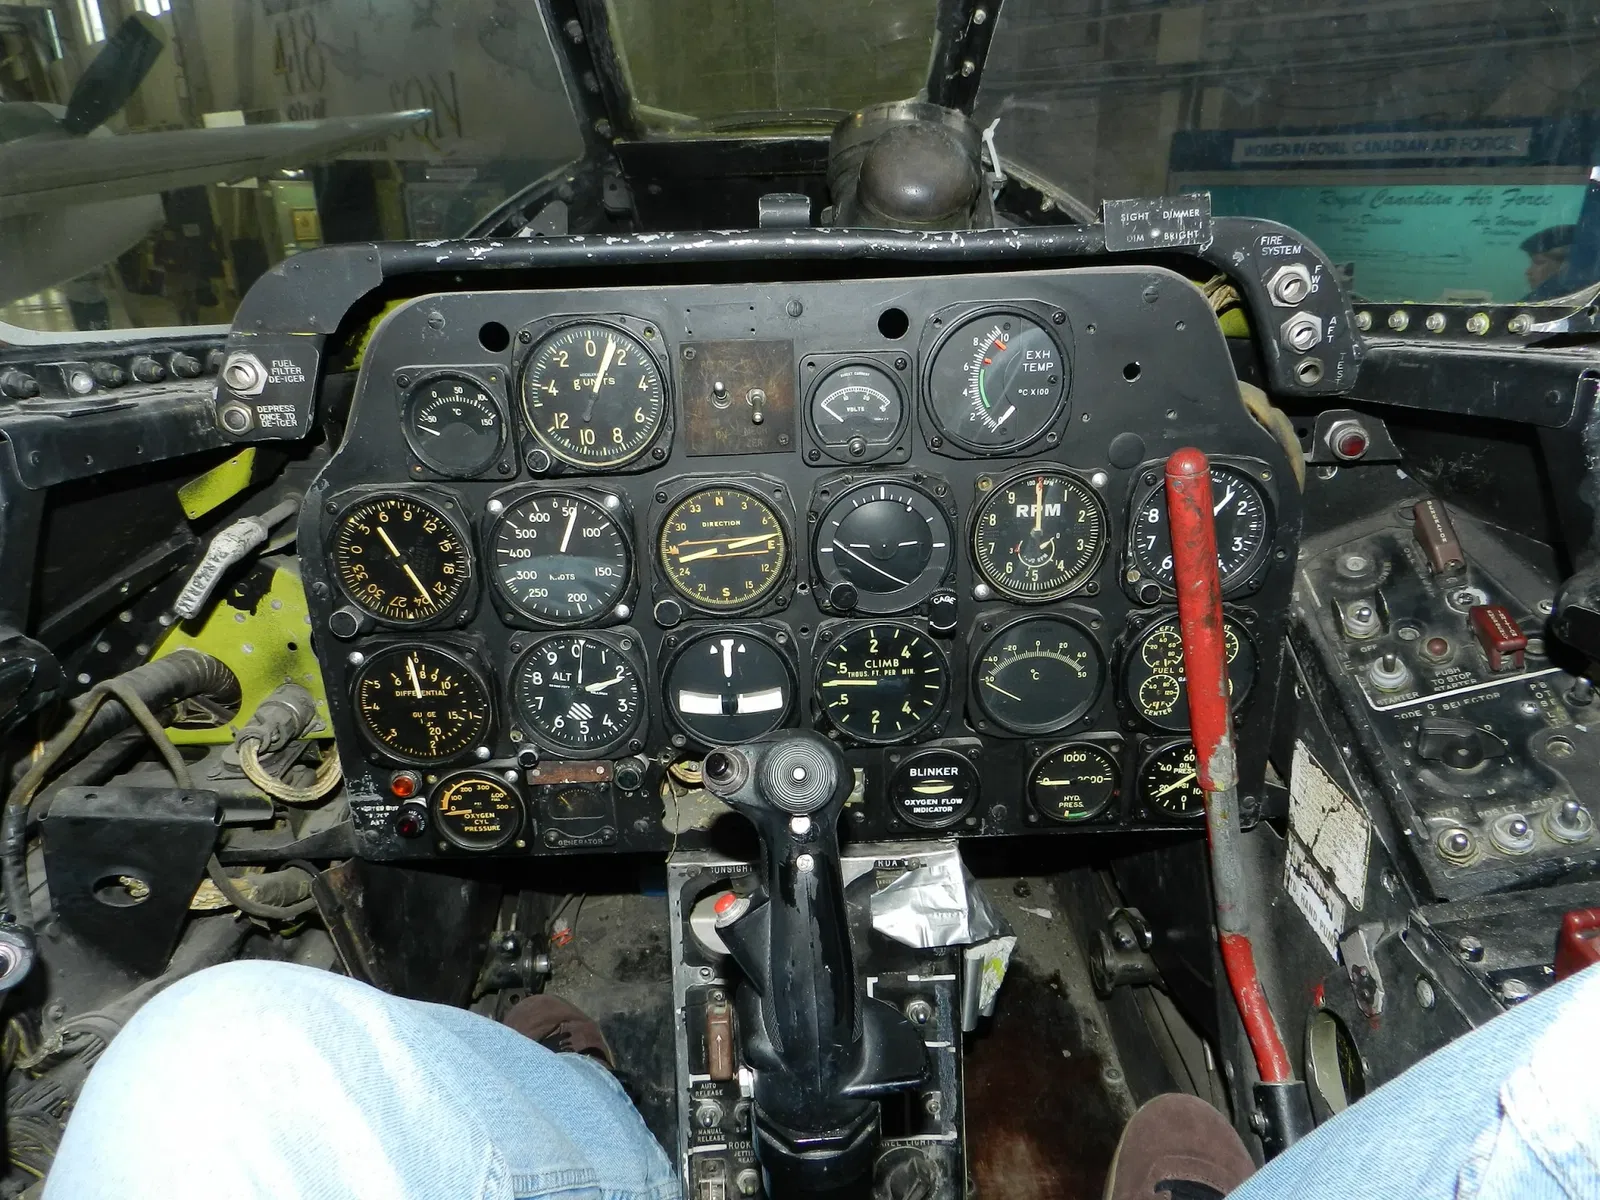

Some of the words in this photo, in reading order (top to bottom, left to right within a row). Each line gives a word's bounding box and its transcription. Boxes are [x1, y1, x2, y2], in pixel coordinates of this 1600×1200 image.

[1244, 142, 1290, 157] WOMEN
[1308, 140, 1349, 155] ROYAL
[1353, 138, 1427, 154] CANADIAN
[1432, 137, 1458, 152] AIR
[1460, 136, 1516, 152] FORCE
[1317, 189, 1366, 210] Royal
[1369, 188, 1453, 210] Canadian
[1458, 188, 1493, 207] Air
[1501, 188, 1553, 209] Force
[1120, 211, 1150, 222] SIGHT
[1162, 208, 1200, 221] DIMMER
[1126, 234, 1145, 243] DIM
[1163, 229, 1200, 242] BRIGHT
[1260, 235, 1283, 246] FIRE
[1261, 245, 1302, 256] SYSTEM
[1310, 264, 1323, 293] FWD
[1326, 316, 1338, 344] AFT
[585, 339, 597, 357] 0
[553, 350, 569, 368] -2
[616, 348, 627, 366] 2
[1026, 350, 1051, 360] EXH
[272, 359, 296, 367] FUEL
[1022, 362, 1054, 372] TEMP
[271, 366, 302, 375] FILTER
[1334, 352, 1347, 386] TEST
[541, 379, 559, 396] -4
[638, 375, 649, 391] 4
[453, 386, 464, 394] 50
[1030, 388, 1050, 396] X100
[256, 404, 296, 413] DEPRESS
[259, 413, 281, 421] ONCE
[286, 412, 296, 420] TO
[634, 406, 645, 423] 6
[554, 412, 570, 429] 12
[579, 428, 595, 445] 10
[612, 427, 624, 443] 8
[715, 496, 724, 506] N
[1008, 492, 1016, 504] 9
[690, 504, 702, 513] 33
[1015, 503, 1061, 518] RPM
[1236, 501, 1248, 516] 2
[379, 511, 389, 522] 6
[403, 510, 413, 521] 9
[529, 512, 550, 523] 600
[989, 513, 997, 526] 8
[1078, 510, 1086, 523] 2
[1148, 508, 1159, 523] 8
[358, 524, 371, 535] 3
[422, 519, 438, 534] 12
[675, 523, 687, 531] 30
[702, 520, 741, 528] DIRECTION
[515, 529, 537, 539] 500
[582, 528, 601, 538] 100
[438, 539, 453, 552] 15
[1076, 538, 1084, 551] 3
[1146, 535, 1157, 550] 7
[1231, 537, 1243, 551] 3
[351, 545, 363, 554] 0
[509, 548, 531, 558] 400
[761, 563, 769, 572] 12
[1005, 561, 1013, 574] 6
[1161, 555, 1172, 570] 6
[352, 563, 369, 581] 33
[443, 562, 455, 575] 18
[594, 567, 612, 576] 150
[679, 567, 691, 576] 24
[516, 570, 537, 580] 300
[432, 581, 447, 596] 21
[698, 583, 706, 592] 21
[745, 580, 754, 589] 15
[367, 583, 386, 599] 30
[528, 588, 549, 598] 250
[722, 587, 731, 597] S
[389, 596, 407, 608] 27
[567, 593, 587, 603] 200
[933, 595, 956, 605] CAGE
[571, 644, 580, 658] 0
[869, 639, 878, 653] 2
[1359, 643, 1378, 653] OFF
[901, 645, 911, 659] 4
[546, 651, 558, 665] 9
[864, 659, 900, 669] CLIMB
[551, 671, 572, 682] ALT
[615, 665, 626, 679] 2
[848, 670, 870, 678] THOUS.
[871, 669, 881, 677] FT.
[1434, 666, 1461, 677] PUSH
[1446, 671, 1472, 683] STOP
[532, 671, 543, 685] 8
[441, 681, 451, 690] 10
[1433, 678, 1478, 692] STARTER
[395, 689, 448, 697] DIFFEENTIAL
[1375, 691, 1421, 706] STARTER
[534, 696, 544, 710] 7
[617, 698, 628, 712] 3
[901, 701, 912, 714] 4
[448, 710, 458, 720] 15
[871, 710, 880, 724] 2
[1143, 707, 1173, 716] CENTER
[554, 715, 565, 728] 6
[602, 713, 614, 728] 4
[429, 727, 442, 736] 20
[580, 721, 589, 735] 5
[1062, 753, 1087, 763] 1000
[1183, 754, 1196, 762] 60
[909, 767, 959, 777] BLINKER
[1160, 763, 1172, 771] 40
[904, 798, 938, 806] OXYGEN
[463, 824, 501, 832] PRESSURE
[557, 838, 604, 846] GENERATOR
[1299, 891, 1318, 922] HAND
[700, 1082, 717, 1090] AUTO
[695, 1089, 724, 1097] RELEASE
[698, 1127, 723, 1135] MANUAL
[697, 1134, 726, 1142] RELEASE
